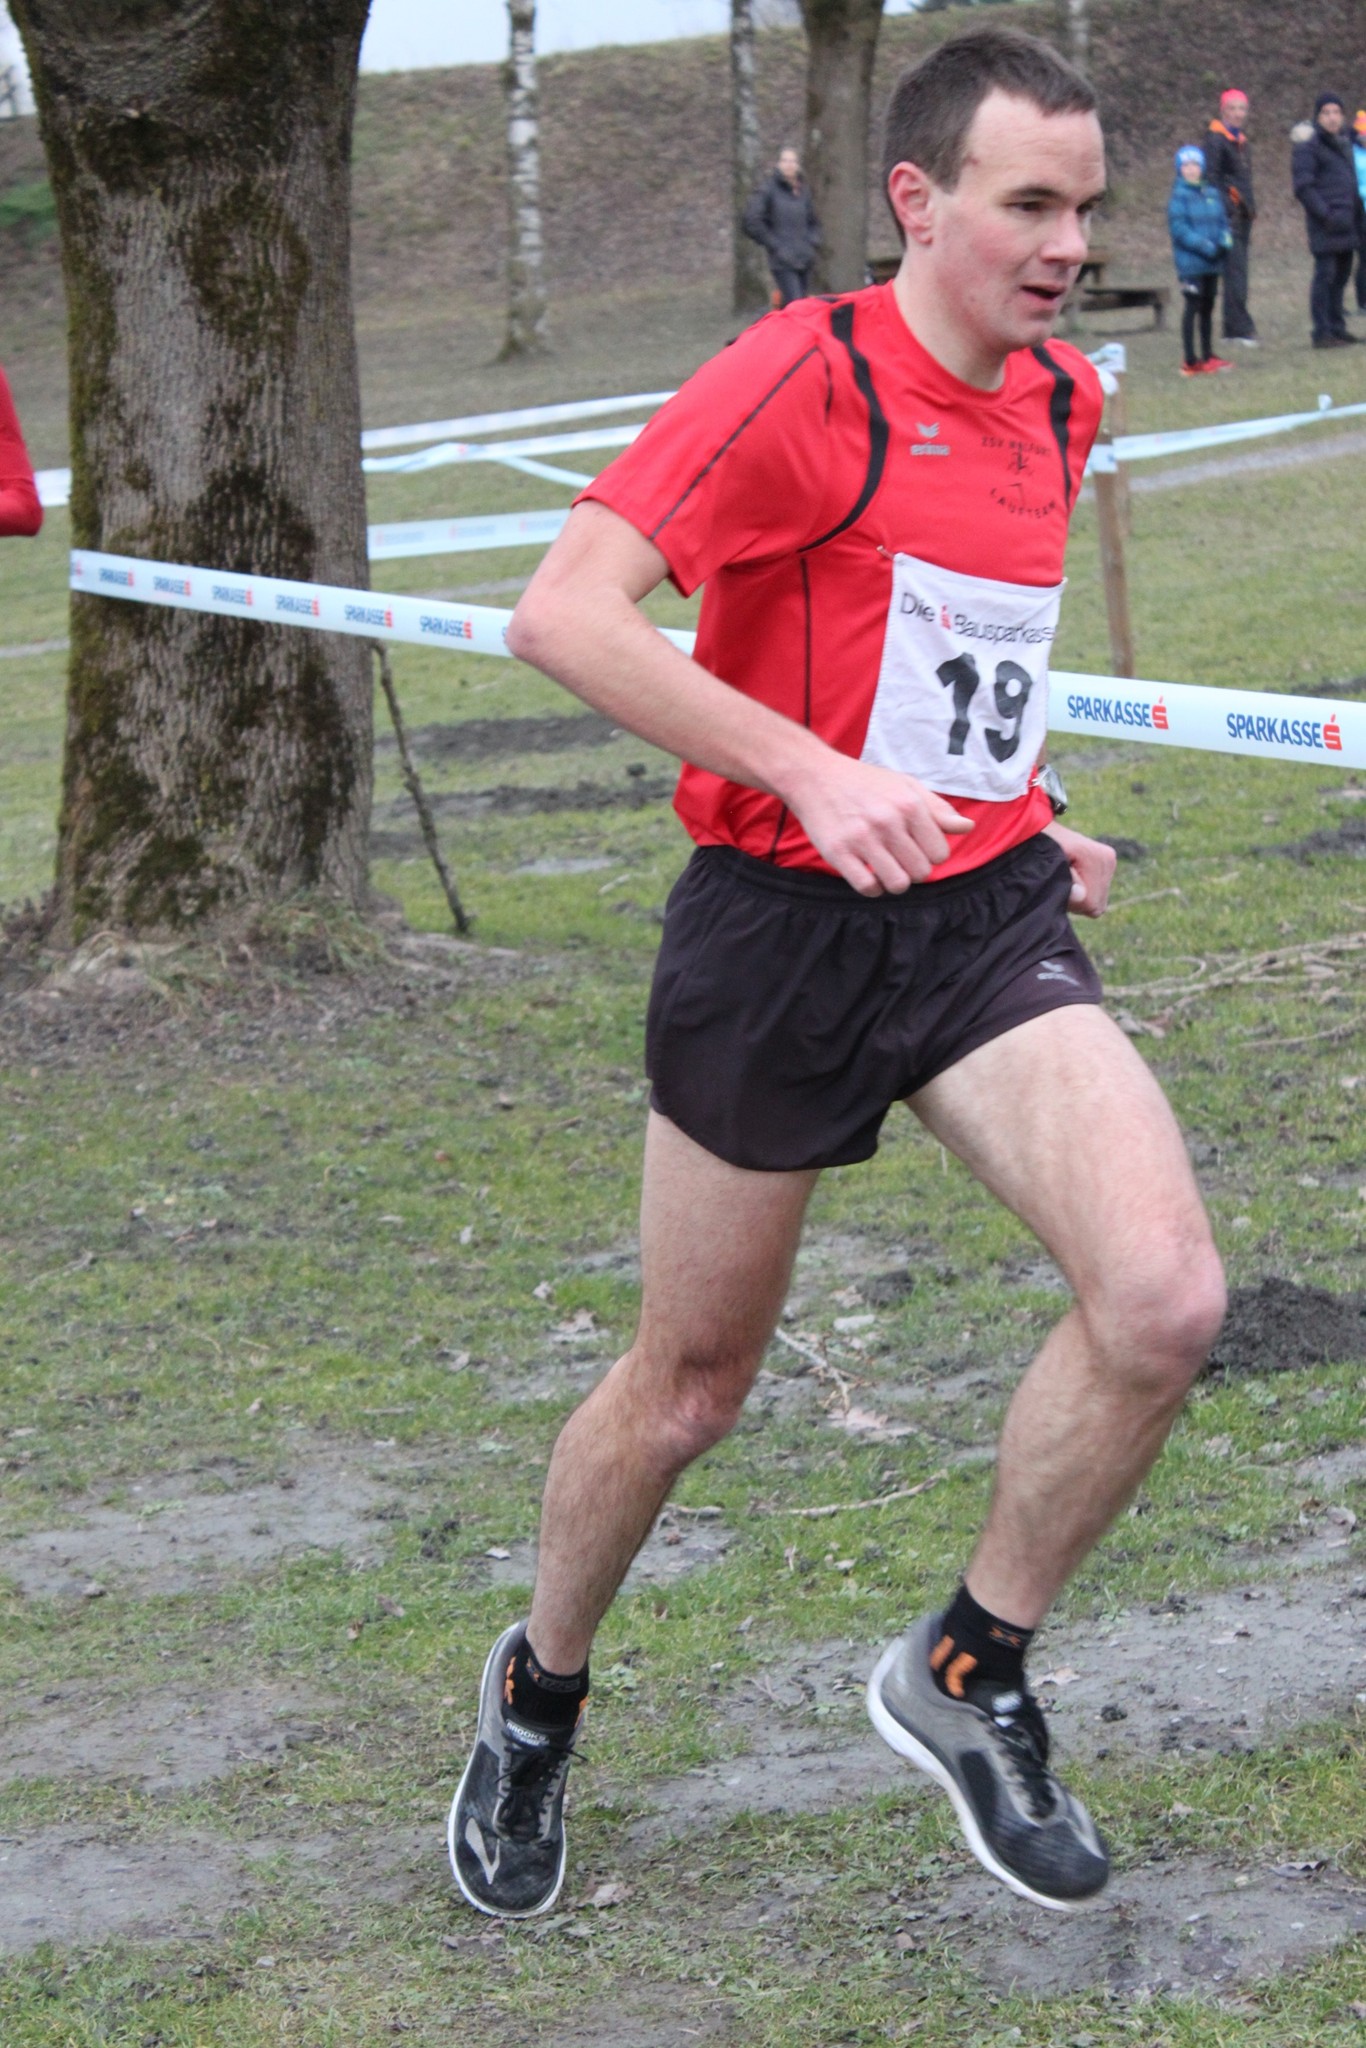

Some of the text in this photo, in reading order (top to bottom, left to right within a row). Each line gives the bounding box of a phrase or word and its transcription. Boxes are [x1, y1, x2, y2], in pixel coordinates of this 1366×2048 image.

[900, 592, 936, 622] Die
[936, 652, 1033, 763] 19
[1067, 694, 1152, 728] SPARKASSE
[1226, 712, 1324, 748] SPARKASSE
